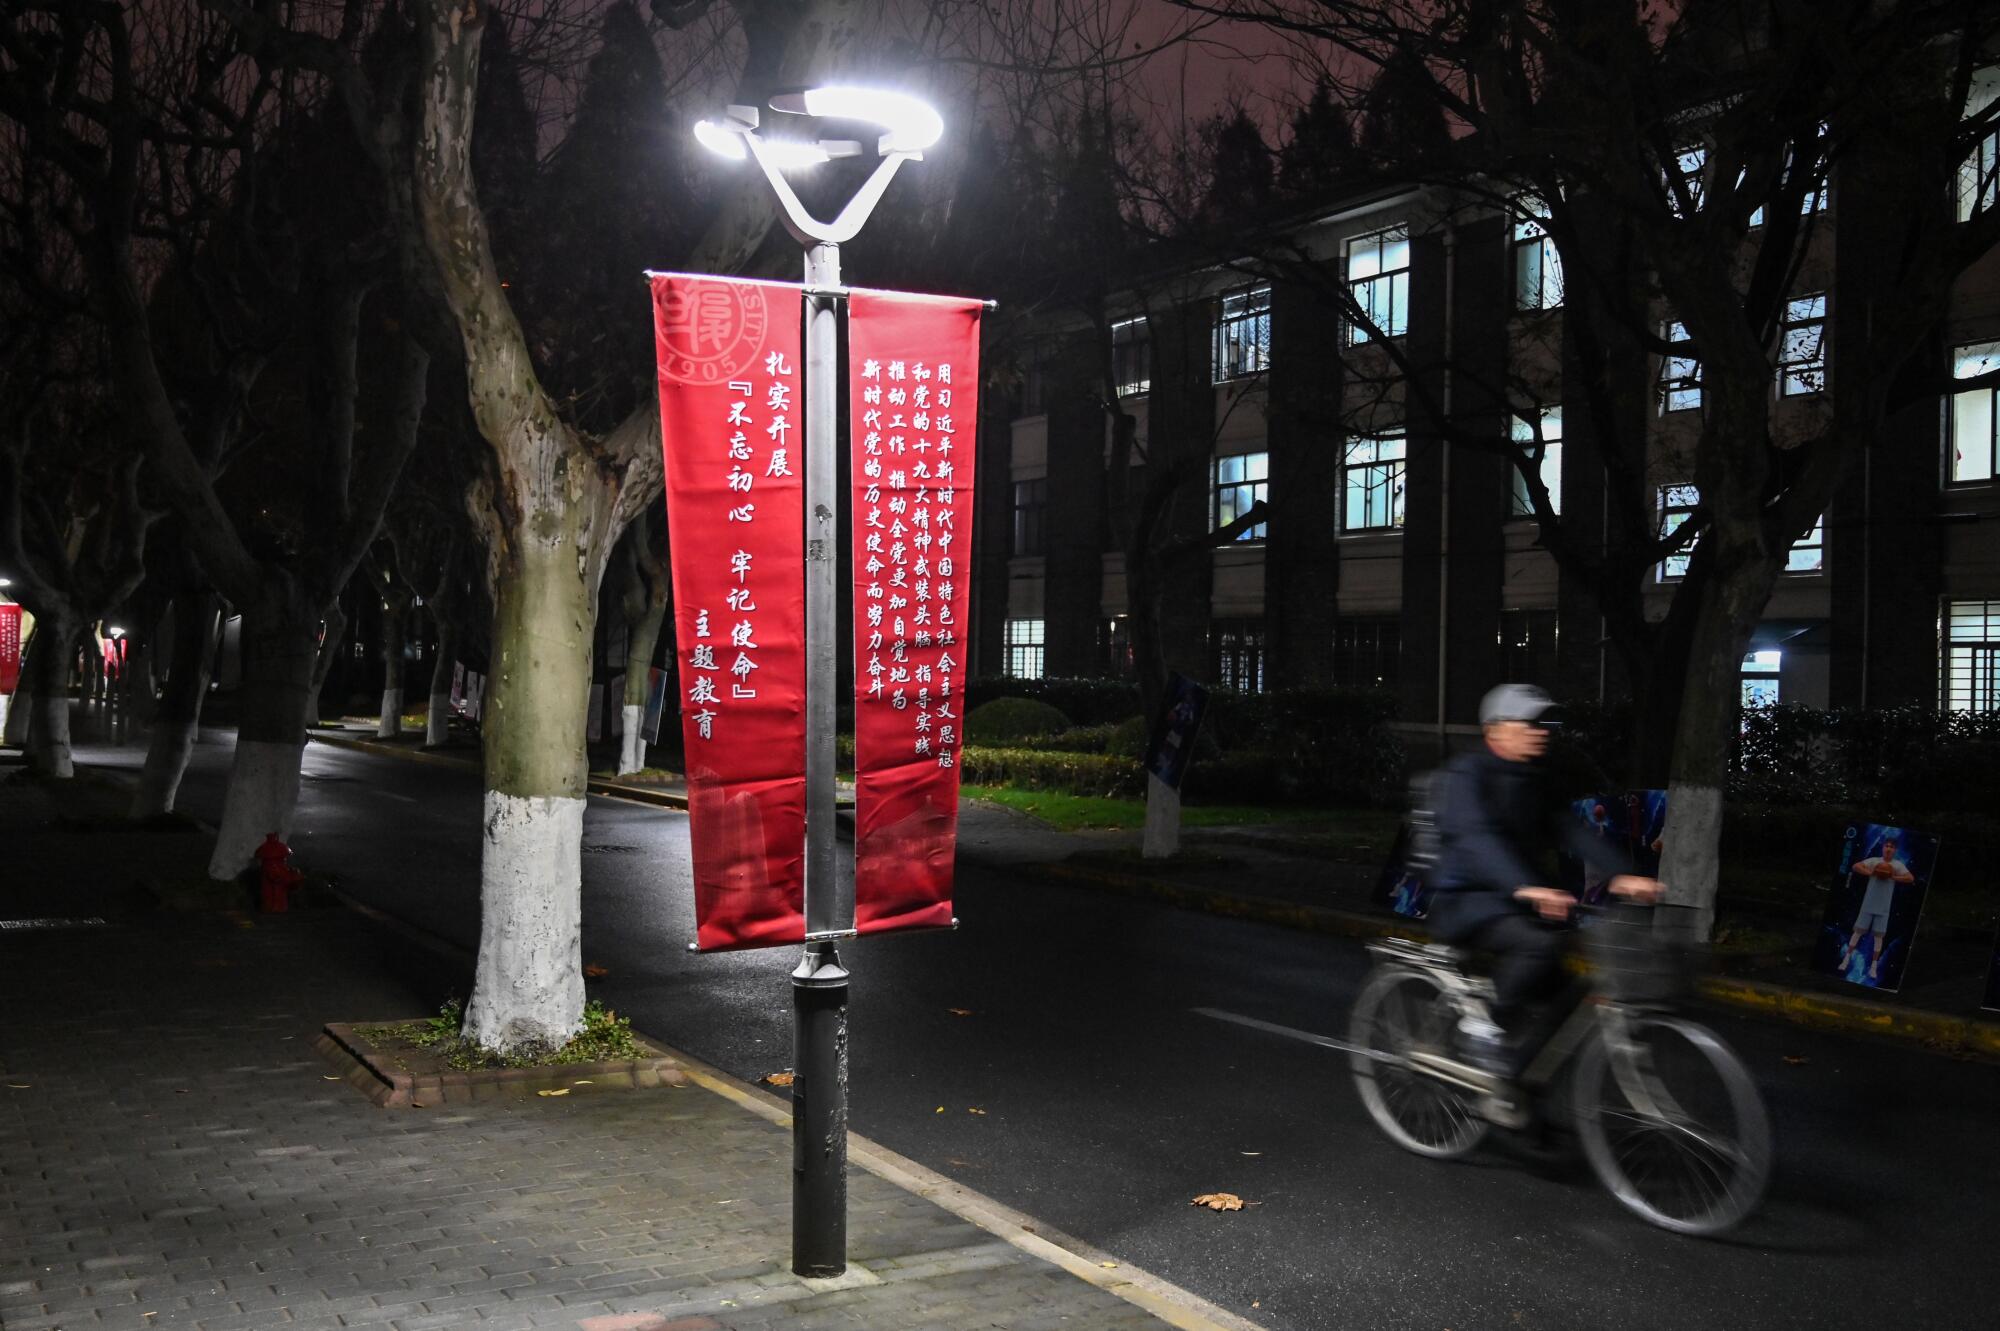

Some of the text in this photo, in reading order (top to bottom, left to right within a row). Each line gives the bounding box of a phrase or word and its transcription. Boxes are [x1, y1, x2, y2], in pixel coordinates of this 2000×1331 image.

[663, 352, 737, 381] 1905
[765, 352, 793, 477] 扎实开展
[887, 360, 907, 456] 推动工作
[861, 358, 887, 700] 新时代党的历史使命而努力奋斗
[935, 363, 957, 768] 用习近平新时代中国特色社会主义思想
[688, 608, 721, 740] 主题教育
[914, 664, 932, 754] 指导实践
